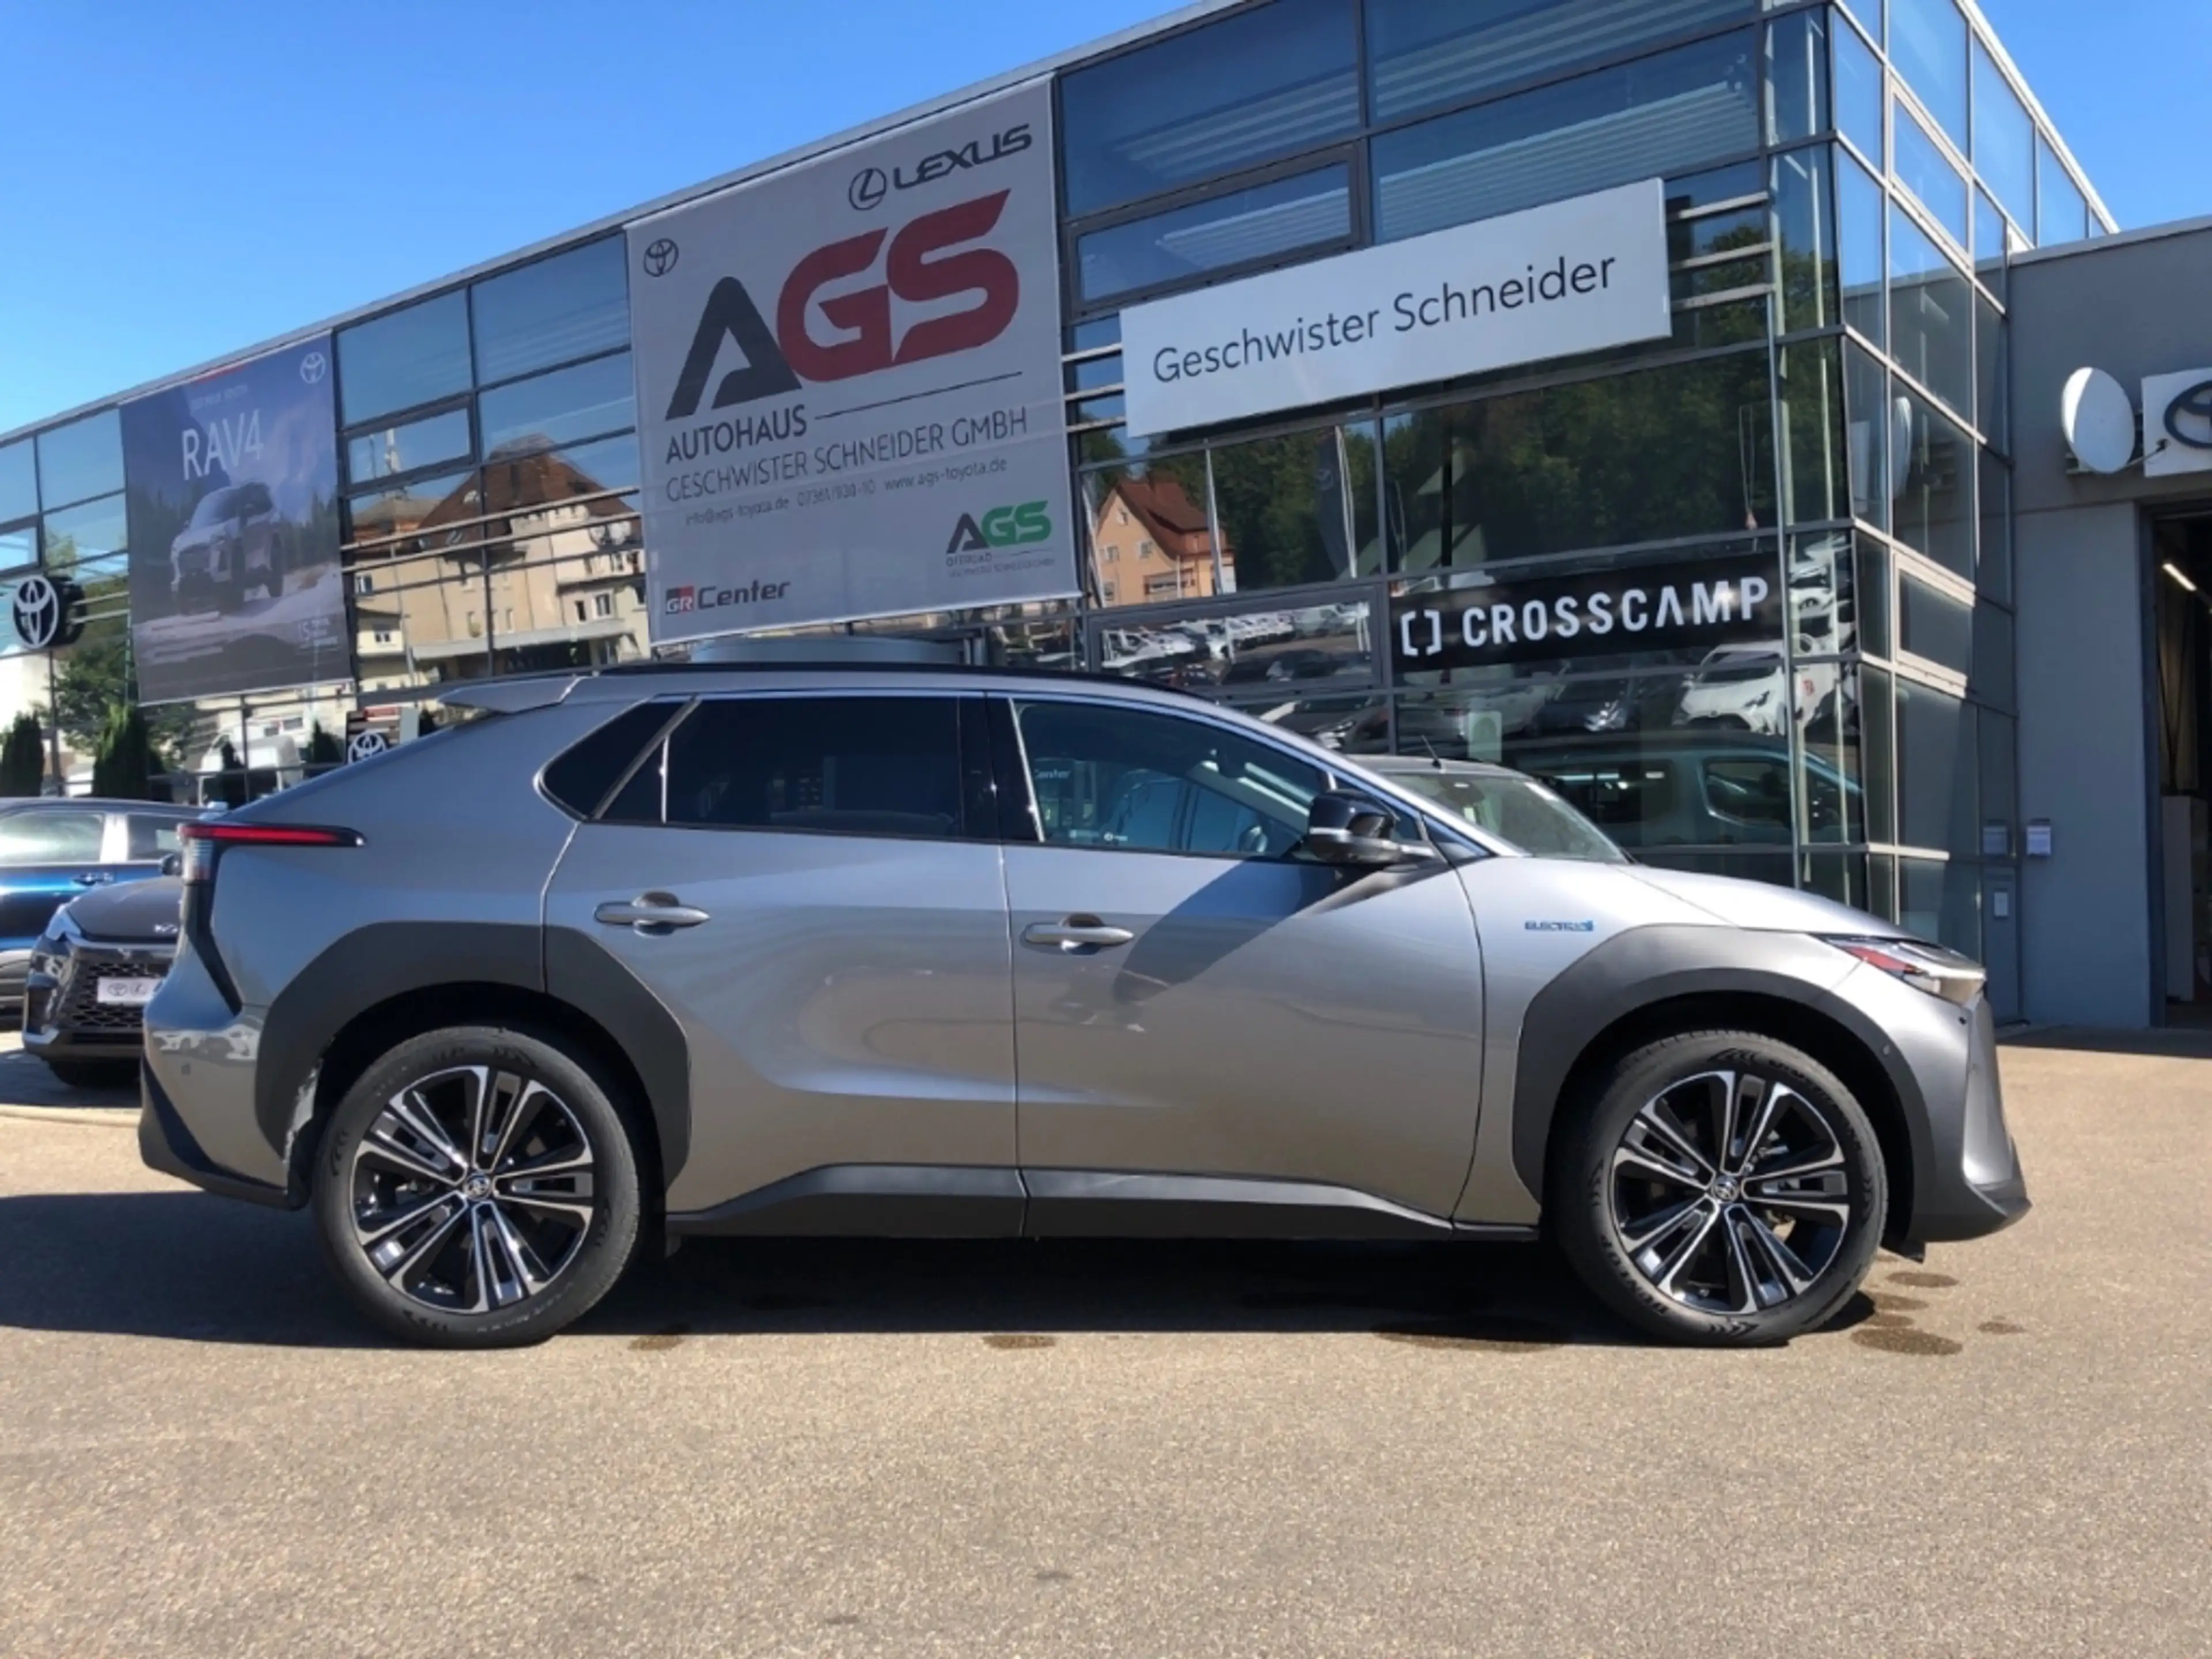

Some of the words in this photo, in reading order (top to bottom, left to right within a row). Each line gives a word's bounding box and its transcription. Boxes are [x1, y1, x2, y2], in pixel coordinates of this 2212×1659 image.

[894, 123, 1032, 190] LEXUS
[665, 188, 1019, 421] AGS
[1153, 309, 1380, 382] Geschwister
[1394, 256, 1615, 332] Schneider
[182, 408, 264, 482] RAV4
[666, 404, 806, 464] AUTOHAUS
[666, 451, 808, 502] GESCHWISTER
[815, 423, 944, 474] SCHNEIDER
[952, 406, 1027, 446] GMBH
[946, 500, 1052, 554] AGS
[698, 579, 791, 609] Center
[1462, 576, 1768, 647] CROSSCAMP
